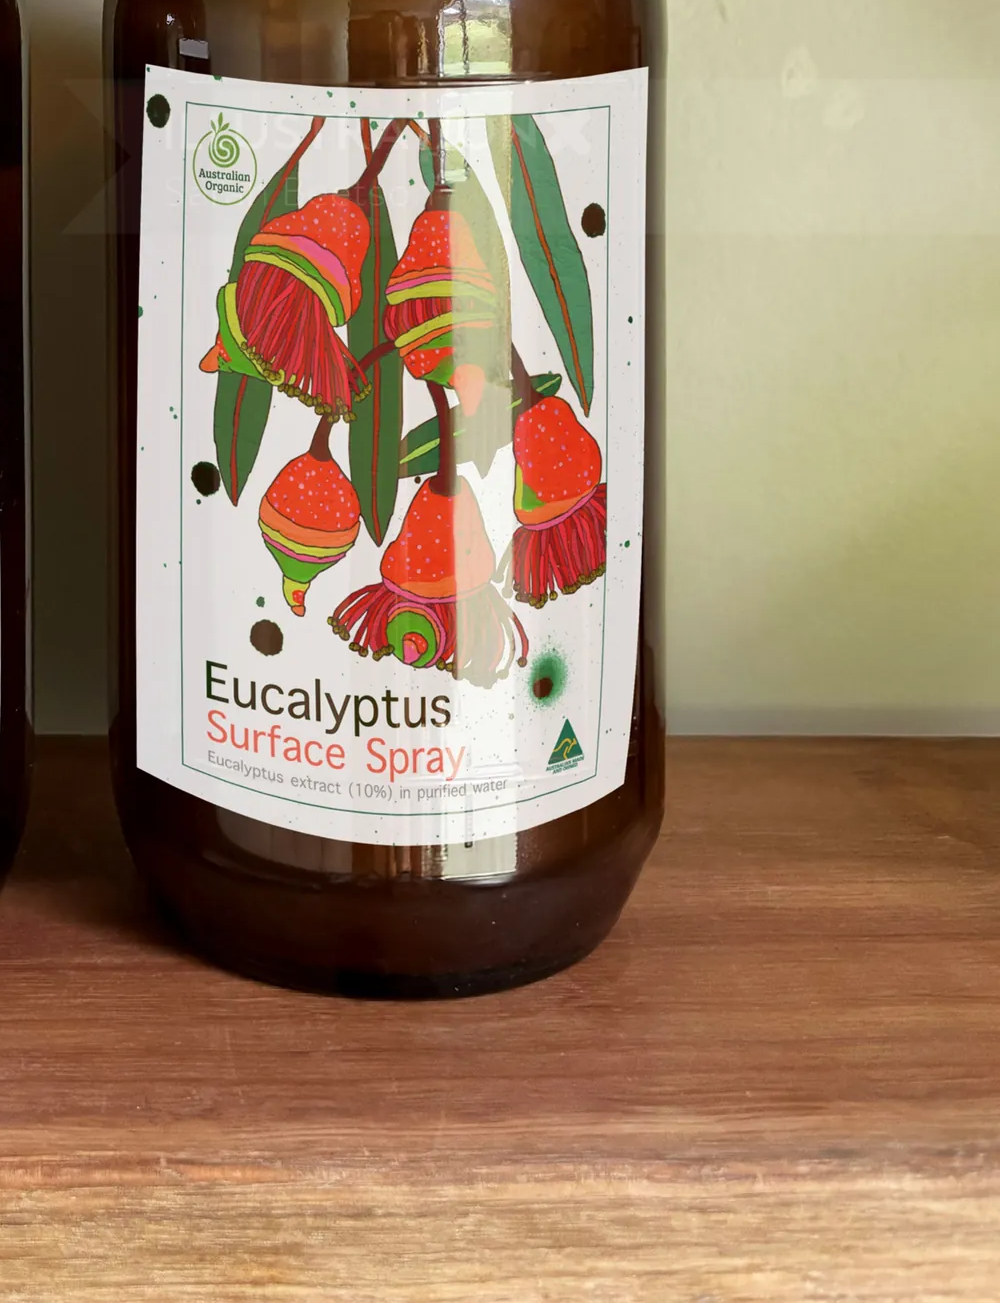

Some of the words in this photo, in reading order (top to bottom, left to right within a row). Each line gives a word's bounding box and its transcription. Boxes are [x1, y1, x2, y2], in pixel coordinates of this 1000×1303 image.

[199, 168, 251, 182] Australian
[205, 181, 244, 194] Organic
[206, 661, 452, 737] Eucalyptus
[207, 710, 345, 770] Surface
[365, 737, 466, 784] Spray
[207, 749, 284, 784] Eucalyptus
[290, 774, 342, 795] extract
[348, 781, 393, 802] (10%)
[400, 785, 411, 799] in
[417, 782, 467, 802] purified
[472, 778, 508, 794] water
